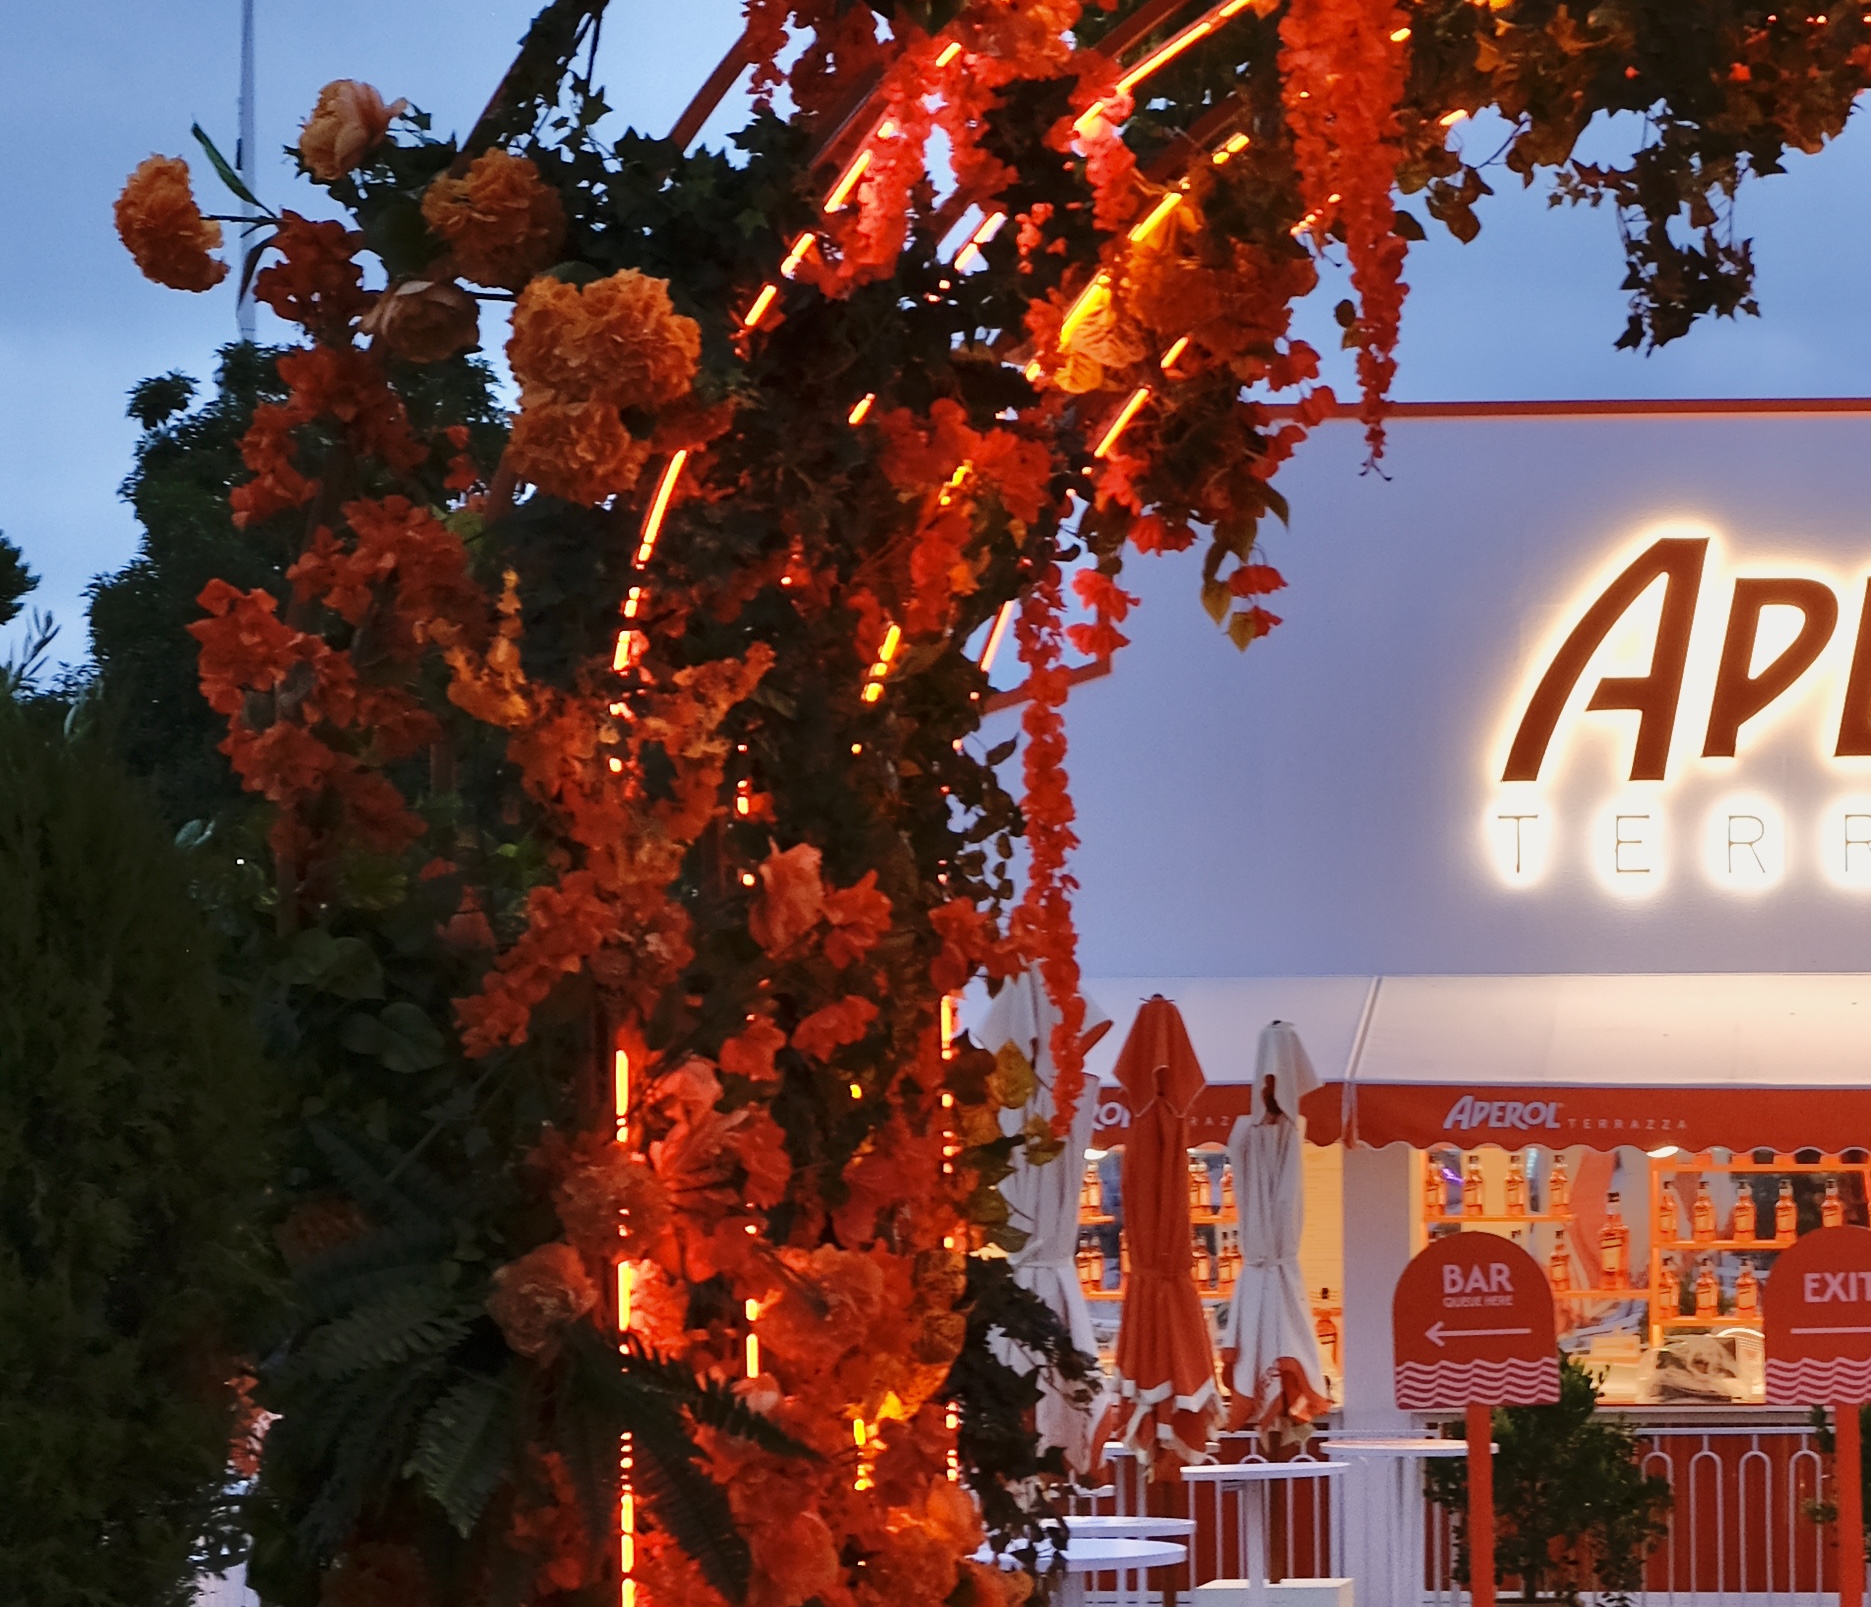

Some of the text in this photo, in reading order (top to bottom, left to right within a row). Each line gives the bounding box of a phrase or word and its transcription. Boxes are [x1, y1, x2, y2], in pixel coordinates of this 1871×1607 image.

[1442, 1095, 1688, 1130] APEROL TERRAZZA
[1442, 1262, 1515, 1294] BAR
